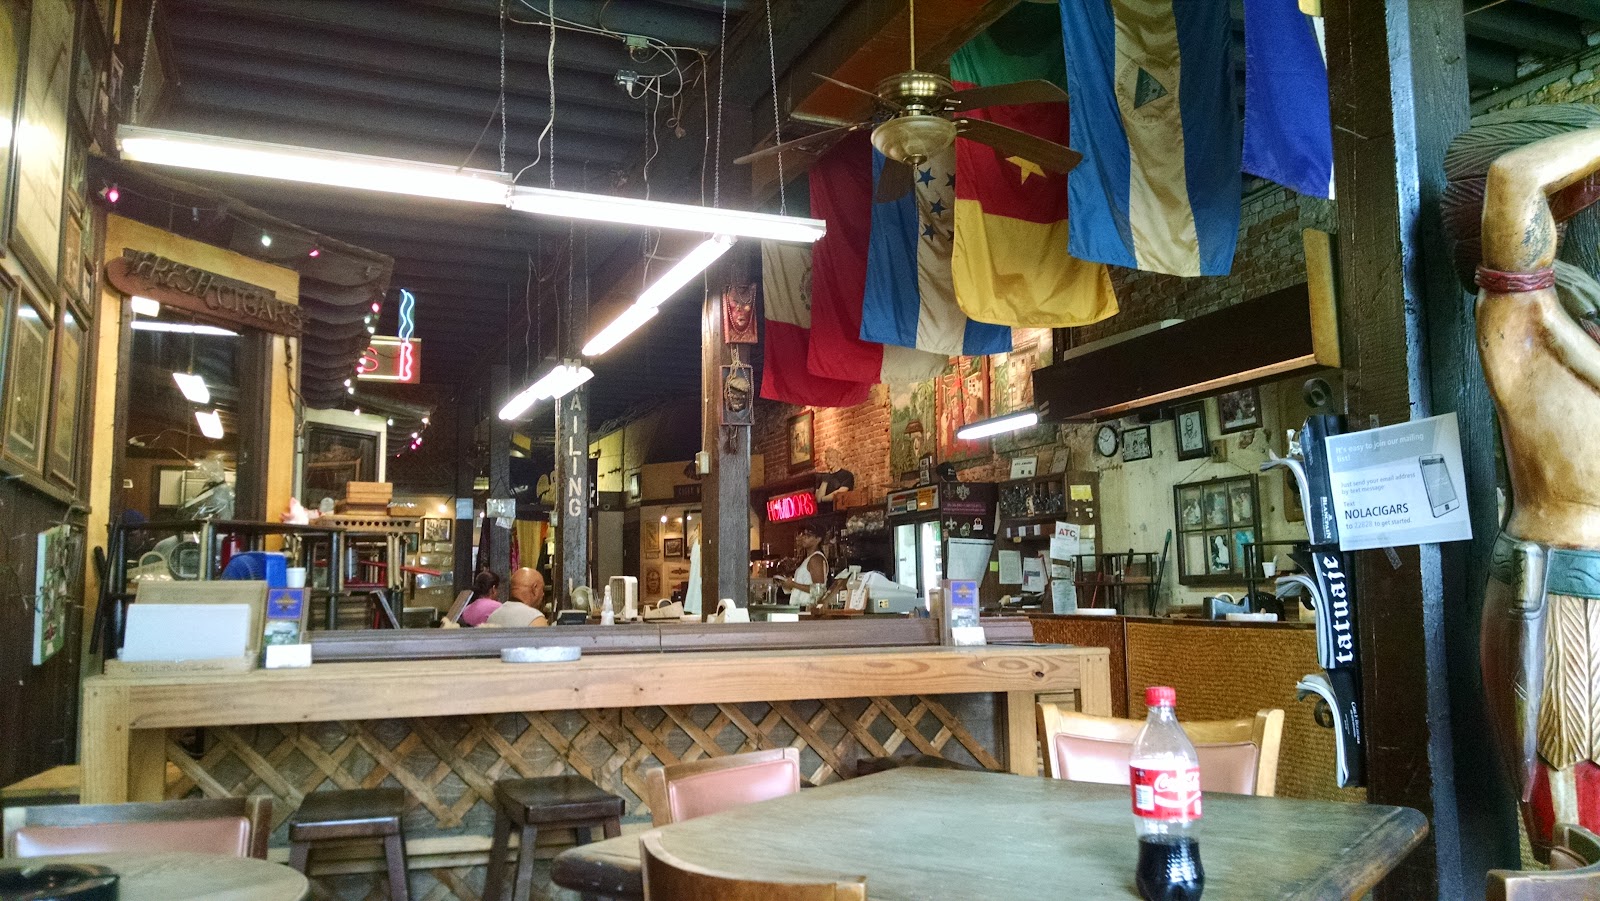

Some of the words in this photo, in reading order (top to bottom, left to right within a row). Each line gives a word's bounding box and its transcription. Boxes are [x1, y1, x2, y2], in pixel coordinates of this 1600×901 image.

[137, 254, 213, 297] FRESH
[208, 286, 303, 327] CIGARS
[1335, 446, 1347, 454] It's
[1348, 444, 1364, 452] easy
[1373, 440, 1386, 450] join
[1399, 433, 1424, 443] mailing
[1353, 479, 1366, 487] send
[1366, 477, 1379, 486] your
[1395, 472, 1416, 480] address
[1341, 487, 1349, 496] by
[1362, 484, 1385, 493] message
[766, 493, 814, 521] HUMIDORS
[1344, 503, 1409, 520] NOLACIGARS
[1374, 519, 1380, 527] to
[1381, 519, 1391, 527] get
[1323, 556, 1354, 663] tatuaje
